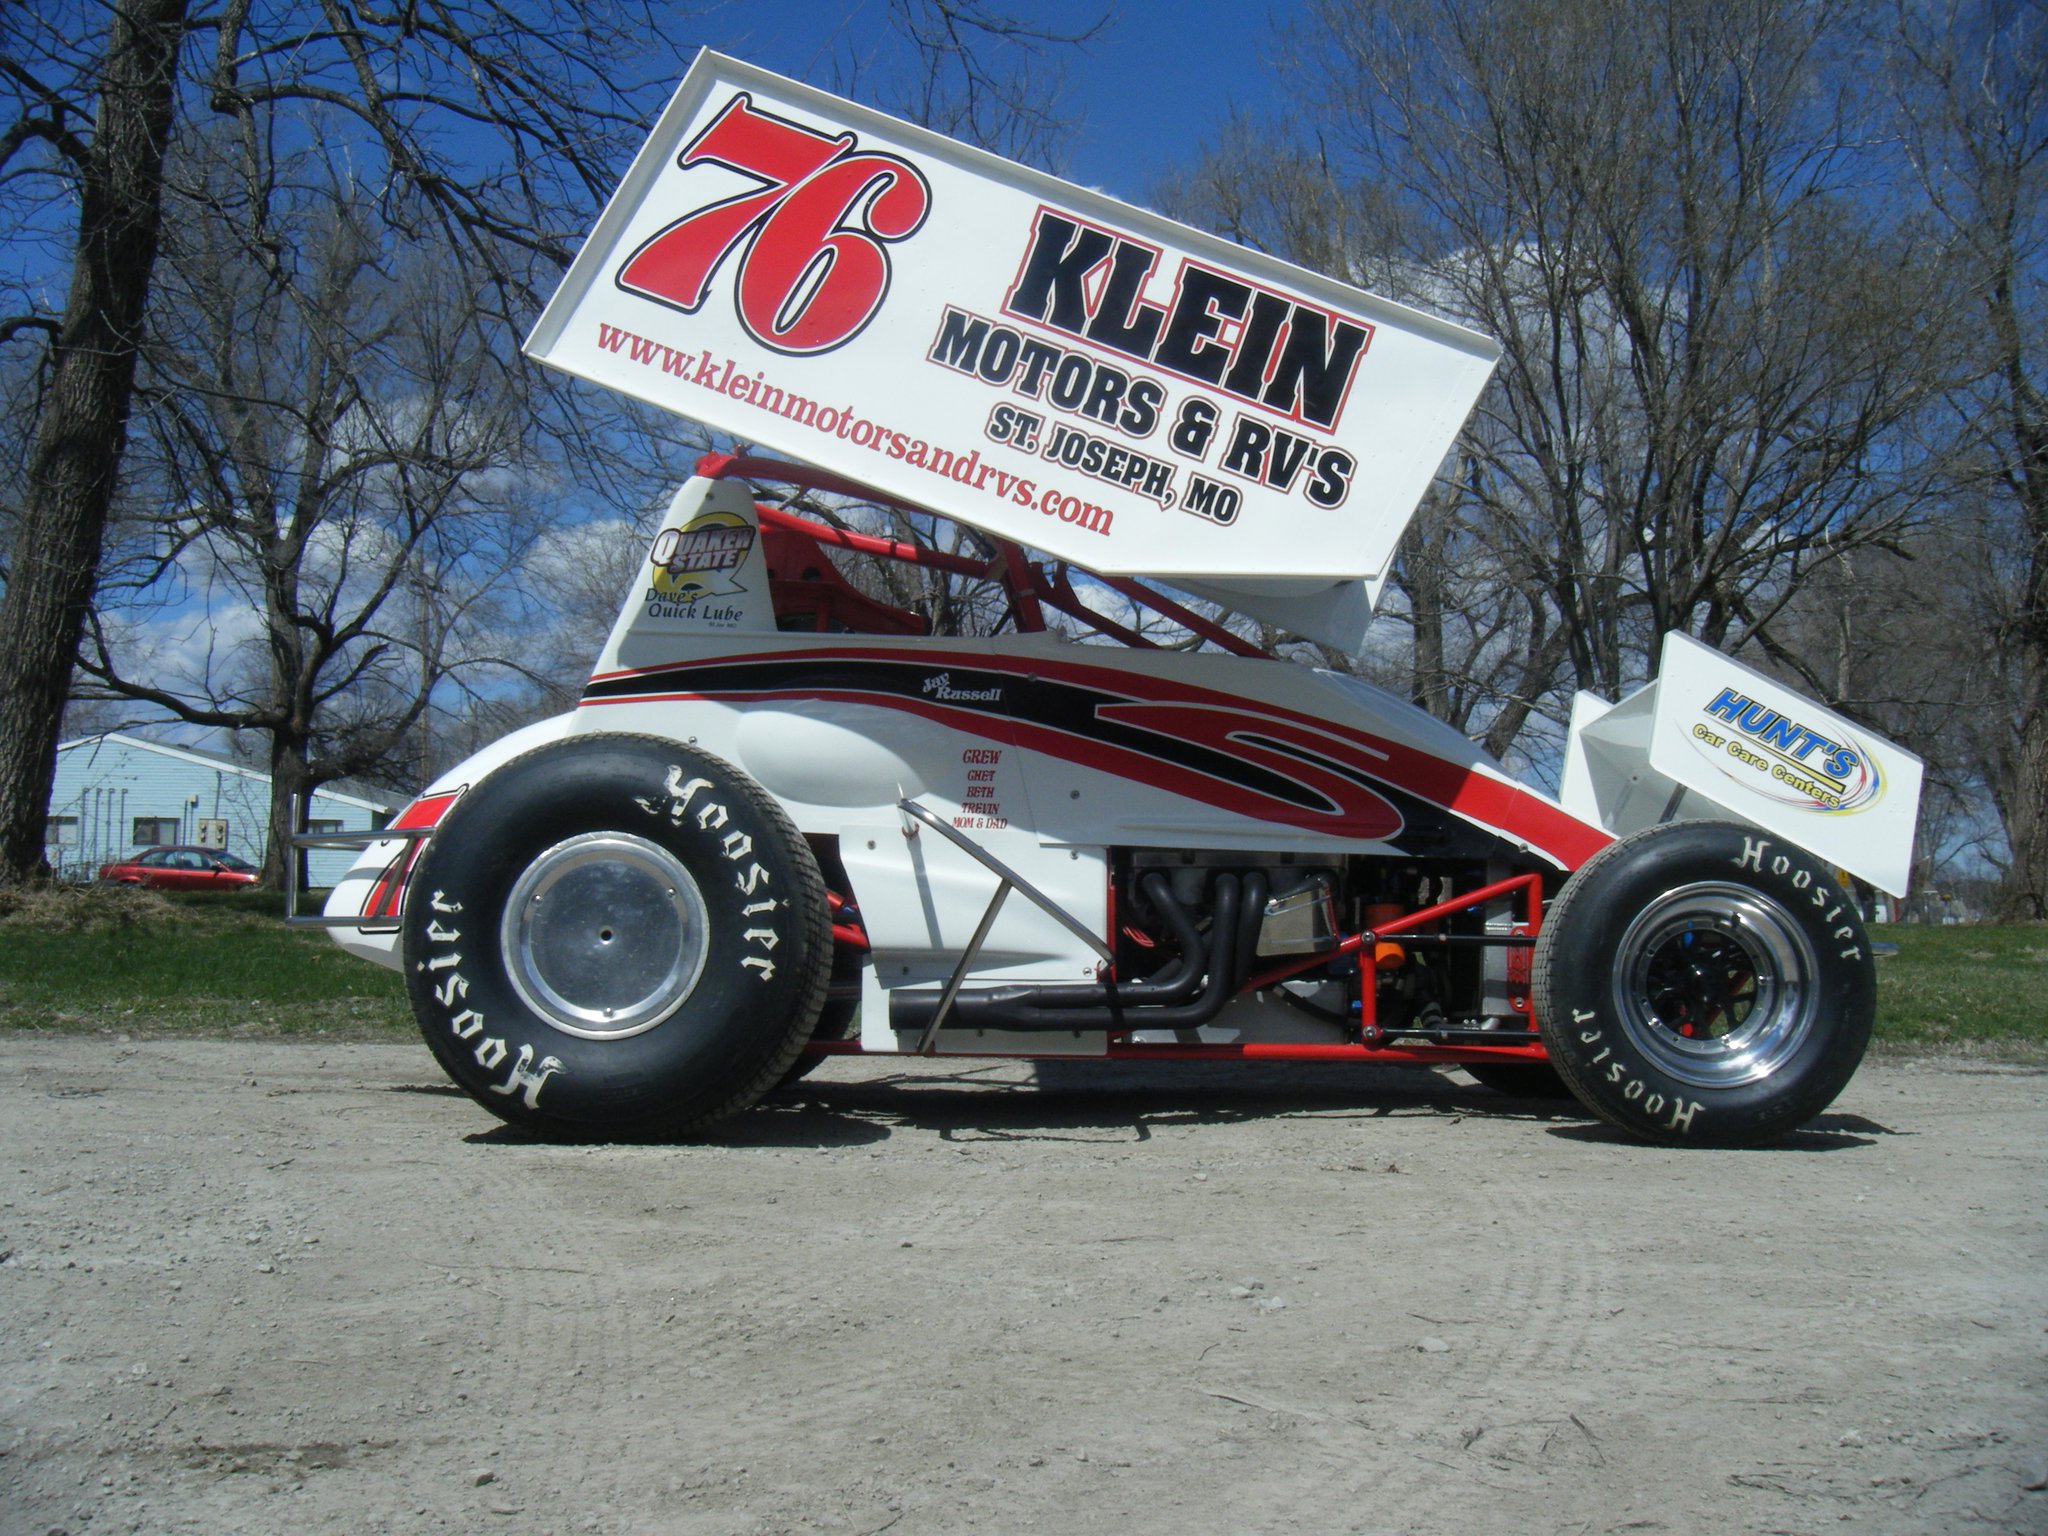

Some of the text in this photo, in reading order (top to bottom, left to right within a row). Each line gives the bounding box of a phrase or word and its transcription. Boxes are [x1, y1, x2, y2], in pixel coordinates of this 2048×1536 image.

[615, 92, 932, 357] 76
[1000, 204, 1375, 435] KLEIN
[597, 323, 1114, 536] www.kleinmotorsandrvs.com
[926, 304, 1358, 510] MOTORS & RV'S
[985, 402, 1243, 527] ST. JOSEPH, MO
[651, 525, 756, 567] QUAKER
[667, 550, 740, 574] STATE
[648, 603, 743, 621] Quick Lube
[922, 672, 950, 692] Jay
[935, 685, 1002, 701] Russell
[1703, 687, 1860, 779] HUNT'S
[952, 817, 1008, 829] MOM & DAD
[1692, 723, 1841, 808] Car Care Centers
[633, 764, 790, 982] Hoosier
[1730, 836, 1861, 961] Hoosier
[417, 890, 569, 1109] Hoosier
[1572, 1008, 1706, 1134] Hoosier
